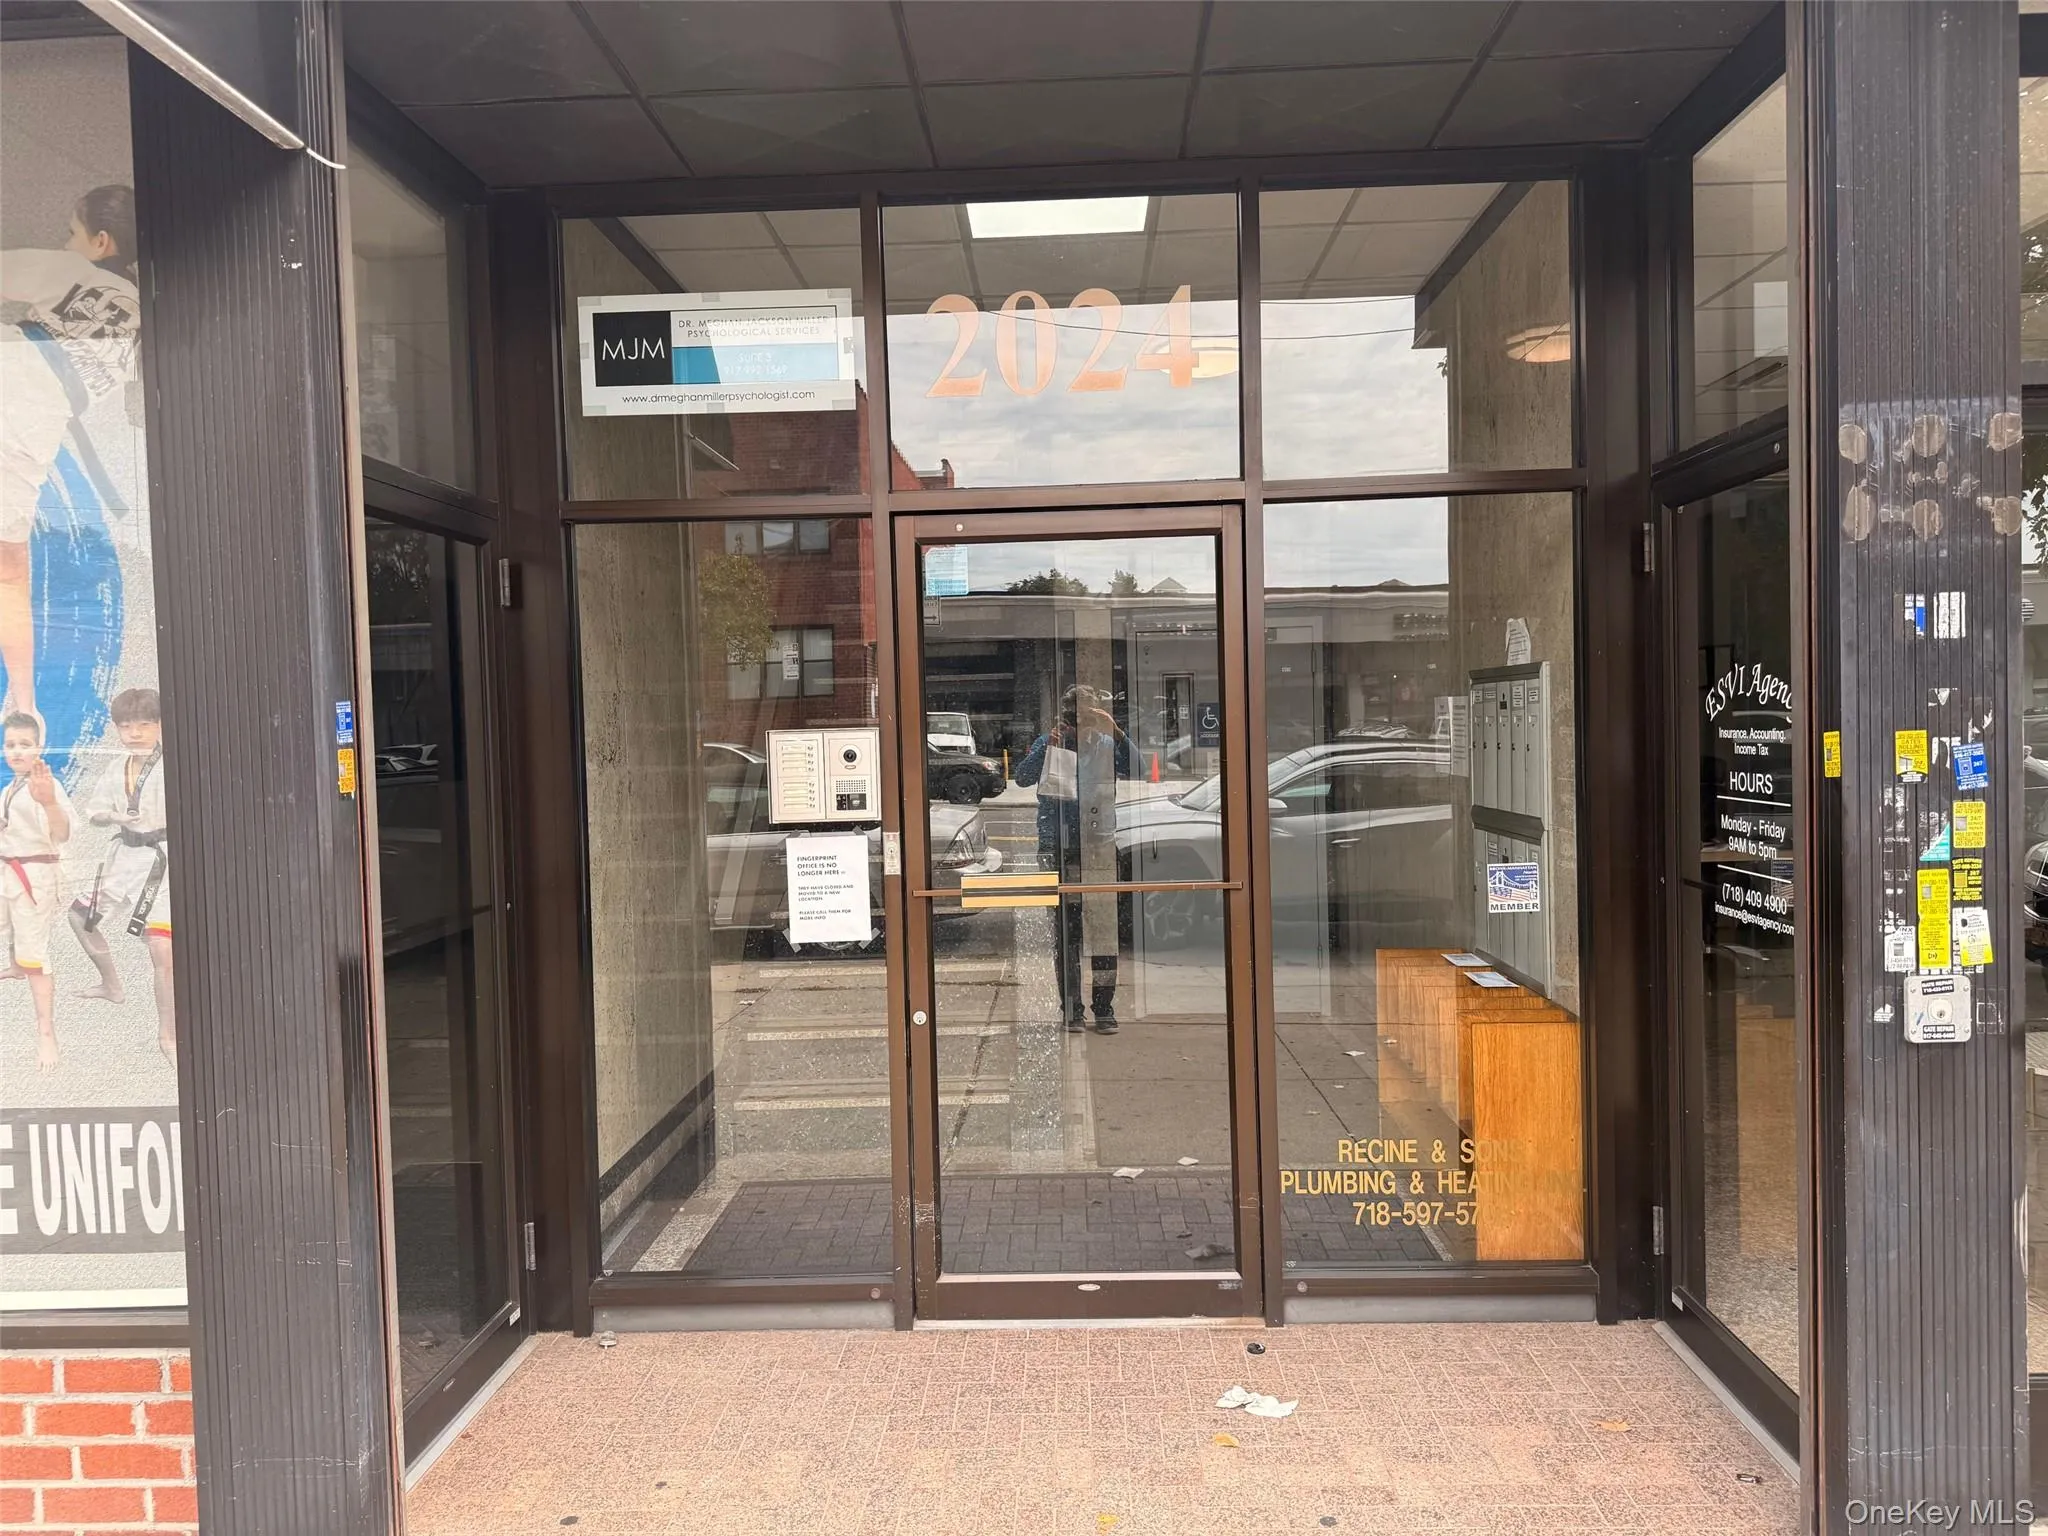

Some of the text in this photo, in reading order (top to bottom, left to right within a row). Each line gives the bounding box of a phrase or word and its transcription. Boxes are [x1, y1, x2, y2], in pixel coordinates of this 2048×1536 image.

[688, 327, 819, 337] PSYCHOLOGICAL SERVICES
[924, 285, 1200, 398] 2024
[602, 338, 665, 360] MJM
[622, 390, 815, 404] www.drmeghanmillerpsychologist.com
[1706, 663, 1792, 723] ESVI Agenc
[1734, 743, 1768, 755] Income Tax
[1730, 771, 1773, 794] HOURS
[1721, 814, 1751, 836] Monday
[1759, 820, 1785, 842] Friday
[1729, 836, 1776, 860] 9AM to 5pm
[1491, 902, 1539, 911] MEMBER
[1722, 883, 1786, 915] (718) 409 4900
[1338, 1139, 1417, 1163] RECINE
[1431, 1139, 1446, 1164] &
[1281, 1171, 1396, 1194] PLUMBING
[1410, 1171, 1425, 1194] &
